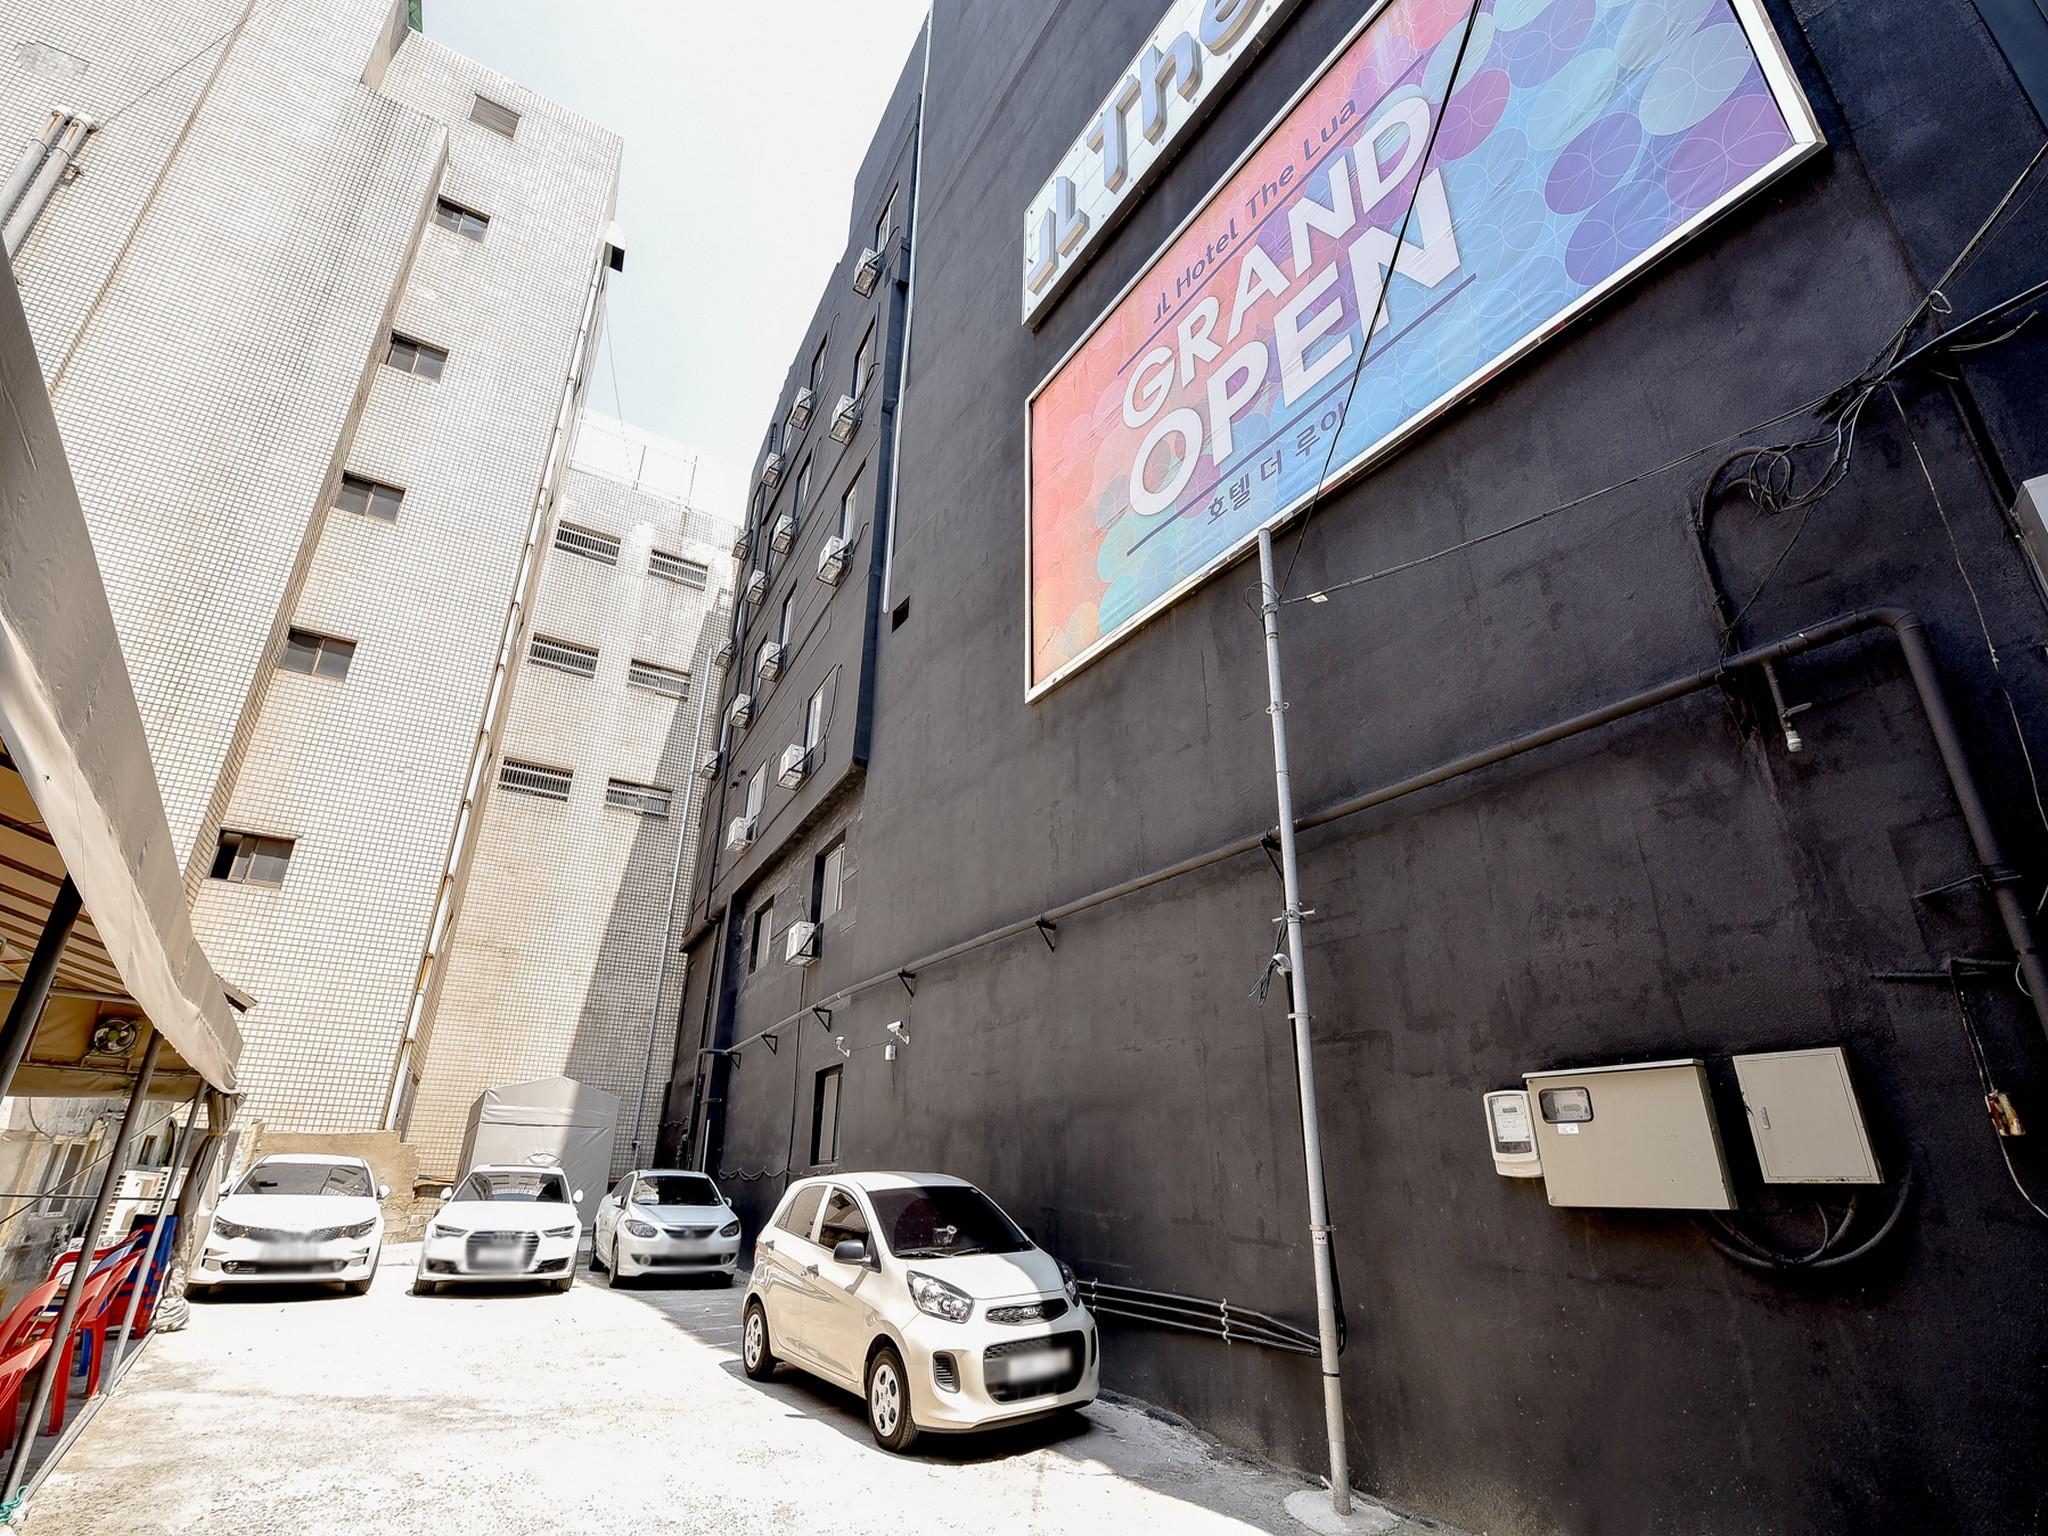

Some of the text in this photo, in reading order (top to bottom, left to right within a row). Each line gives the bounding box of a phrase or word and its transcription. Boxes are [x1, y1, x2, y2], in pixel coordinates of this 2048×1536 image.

[1122, 97, 1431, 428] GRAND
[1175, 218, 1239, 298] Hotel
[1245, 164, 1295, 219] The
[1303, 99, 1356, 161] Lua
[1129, 168, 1461, 516] OPEN
[1207, 473, 1251, 525] 호텔
[1260, 449, 1282, 481] 더
